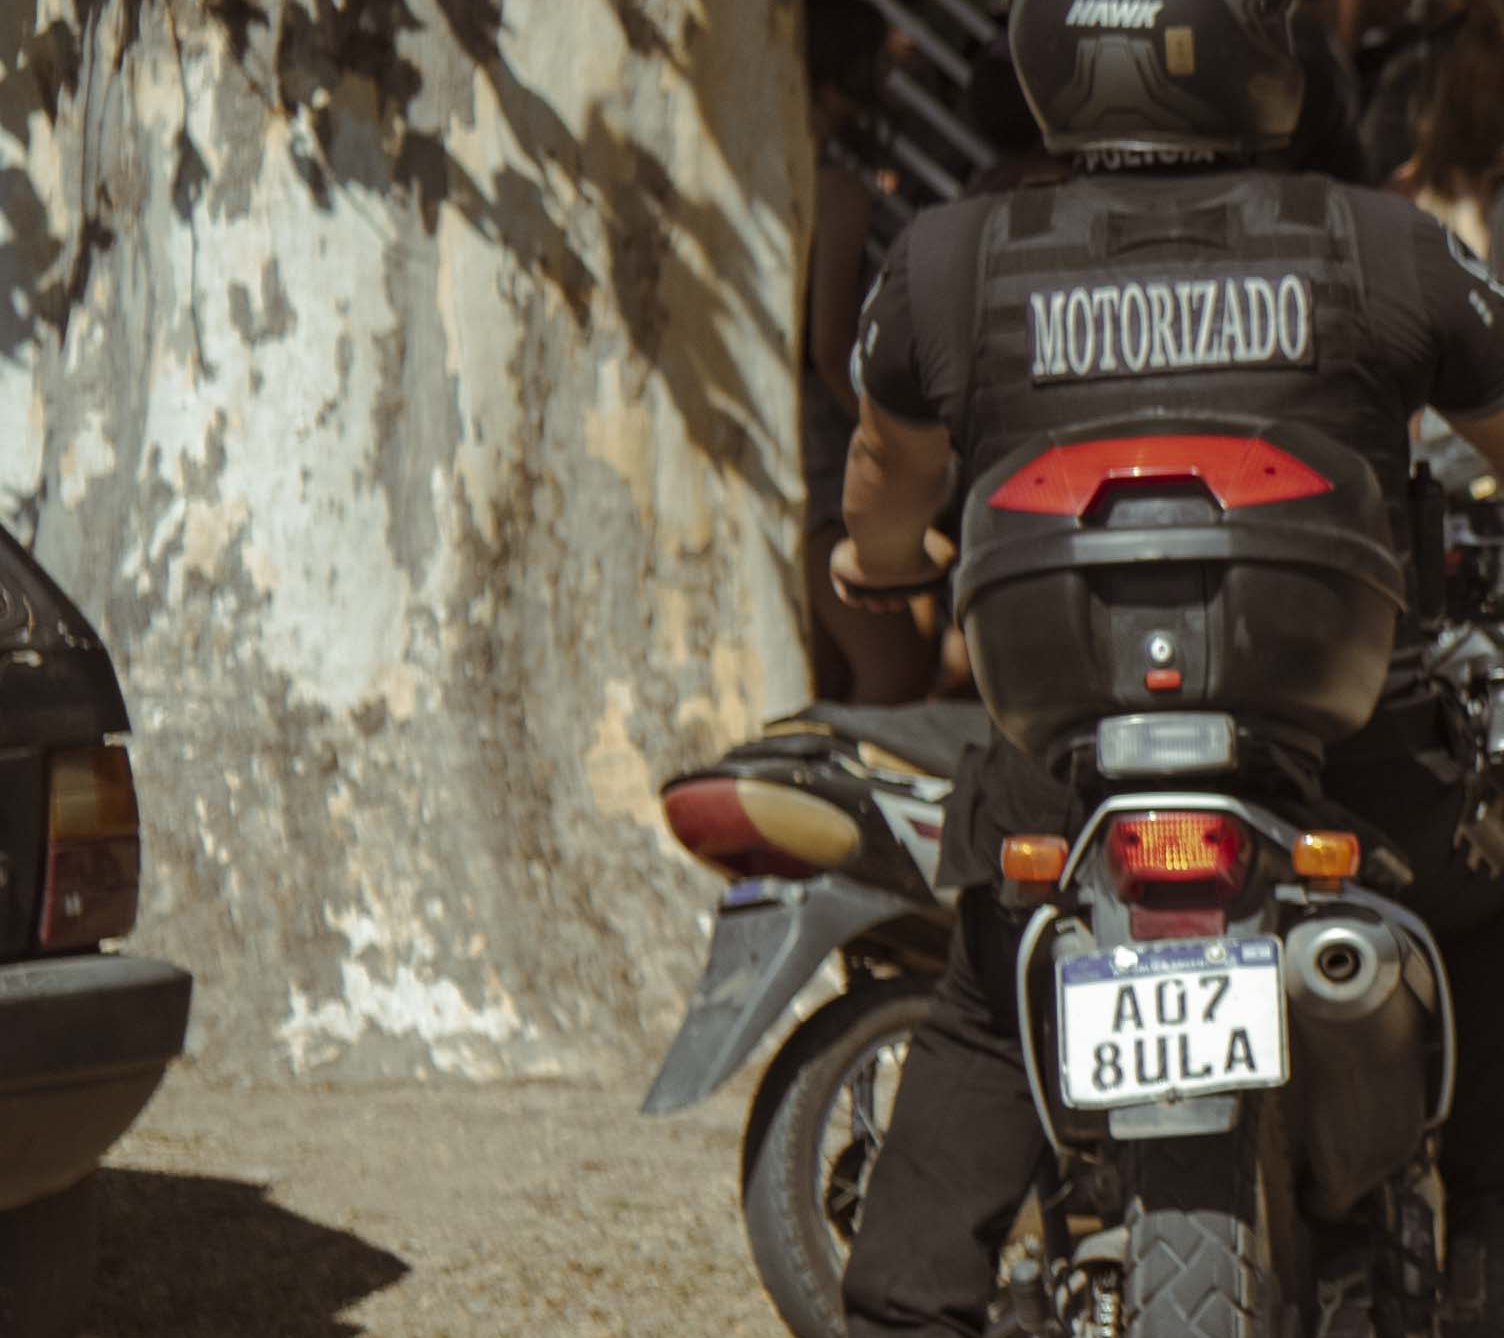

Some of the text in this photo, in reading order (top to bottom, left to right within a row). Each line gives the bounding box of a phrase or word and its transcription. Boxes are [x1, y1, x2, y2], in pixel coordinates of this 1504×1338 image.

[1029, 273, 1309, 376] MOTORIZADO
[1112, 974, 1231, 1034] A07
[1091, 1027, 1258, 1092] 8ULA
